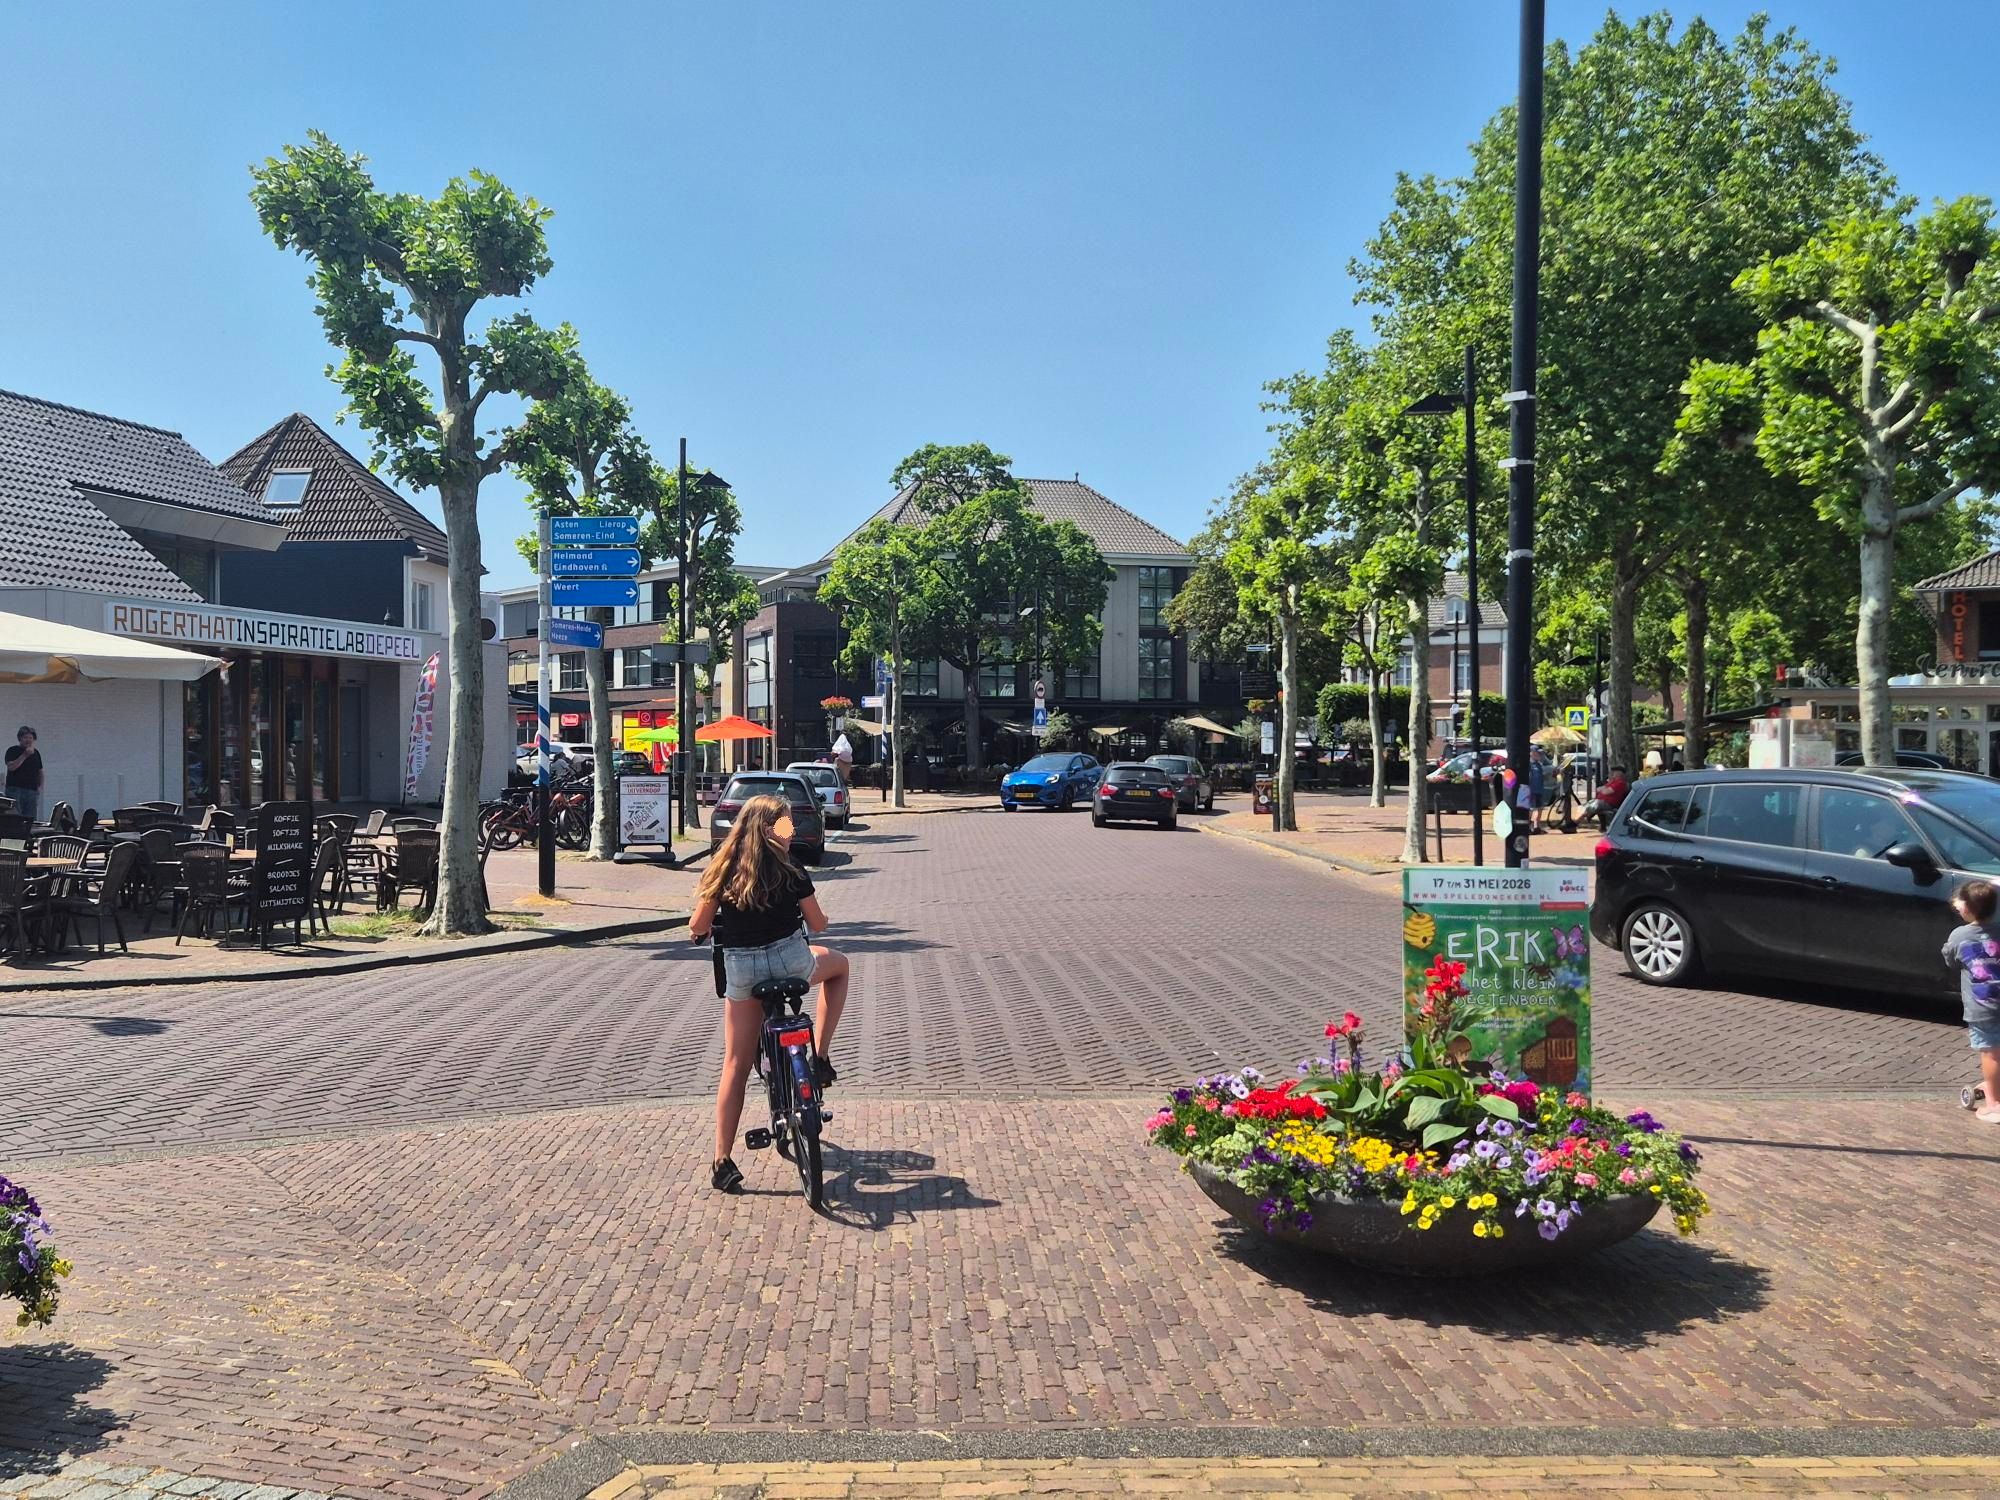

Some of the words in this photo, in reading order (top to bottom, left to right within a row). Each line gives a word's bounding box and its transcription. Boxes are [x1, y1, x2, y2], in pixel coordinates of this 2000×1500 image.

[554, 520, 579, 528] Asten
[599, 520, 627, 529] Lierop
[554, 532, 615, 540] Someren-Eind
[553, 552, 593, 560] Helmond
[553, 563, 599, 571] Eindhoven
[553, 583, 580, 591] Weert
[551, 621, 592, 633] Someren-Heide
[1951, 591, 1968, 660] HOTEL
[273, 815, 300, 823] KOFFIE
[267, 842, 304, 851] MILKSHAKE
[1433, 878, 1445, 888] 17
[1463, 878, 1475, 889] 31
[1478, 878, 1500, 889] MEI
[1502, 878, 1532, 889] 2026
[269, 884, 297, 893] SALADES
[1447, 923, 1546, 968] ERIK
[1472, 967, 1503, 989] het
